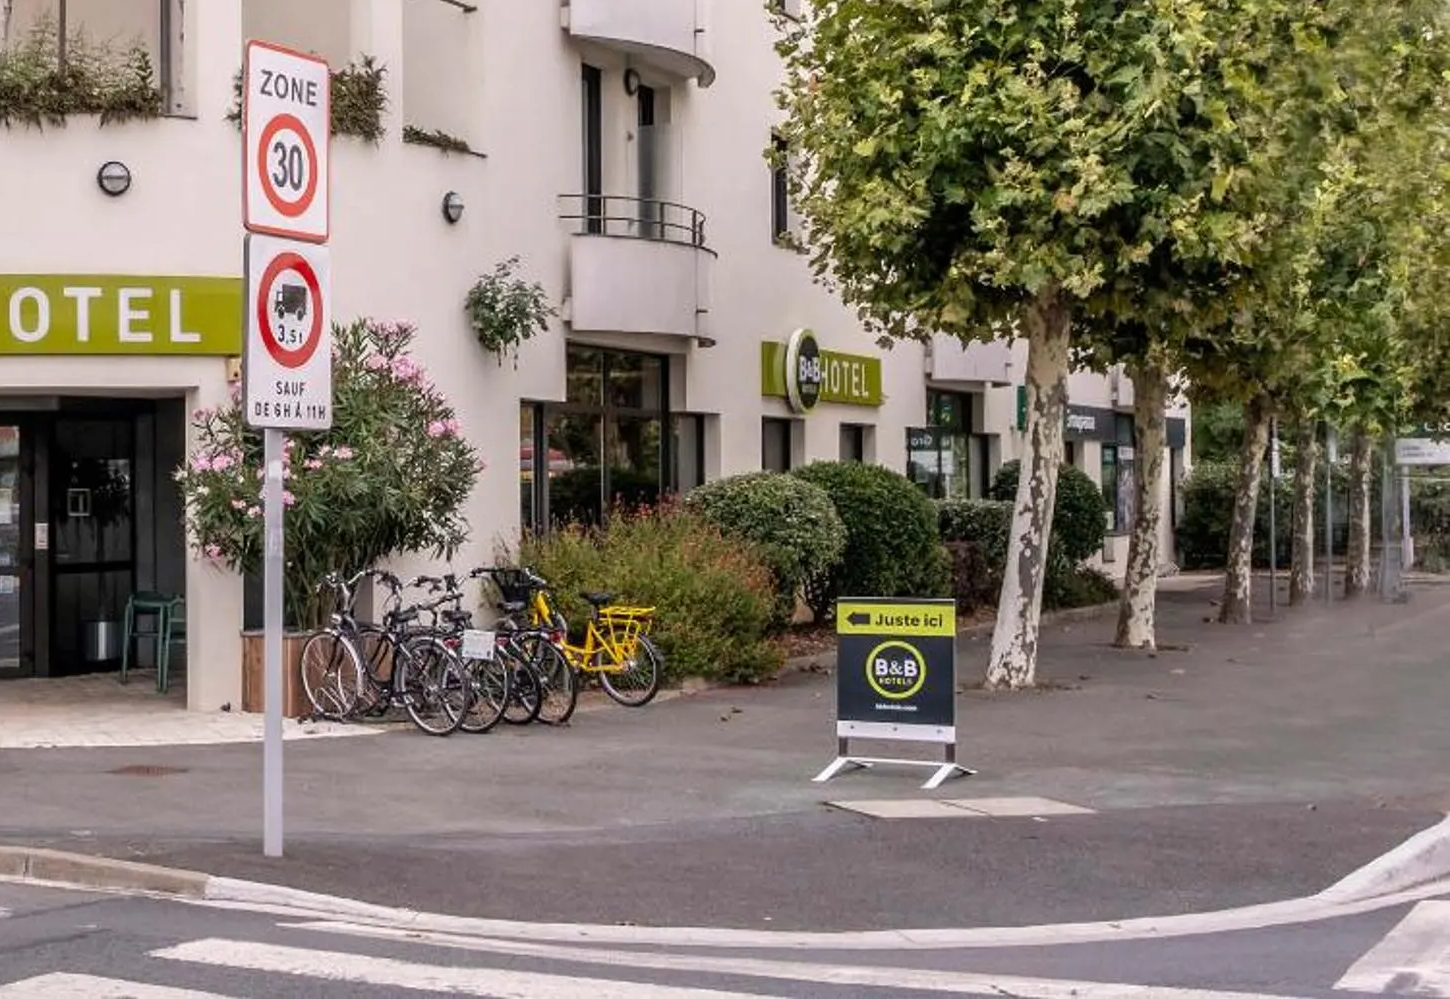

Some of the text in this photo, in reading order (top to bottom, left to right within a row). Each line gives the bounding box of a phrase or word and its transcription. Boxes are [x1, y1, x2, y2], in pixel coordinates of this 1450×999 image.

[260, 69, 318, 106] ZONE
[273, 141, 304, 191] 30
[819, 357, 869, 397] HOTEL
[276, 381, 306, 396] SAUF
[255, 403, 269, 417] DE
[875, 613, 943, 628] Juste ici
[875, 658, 918, 677] B&B
